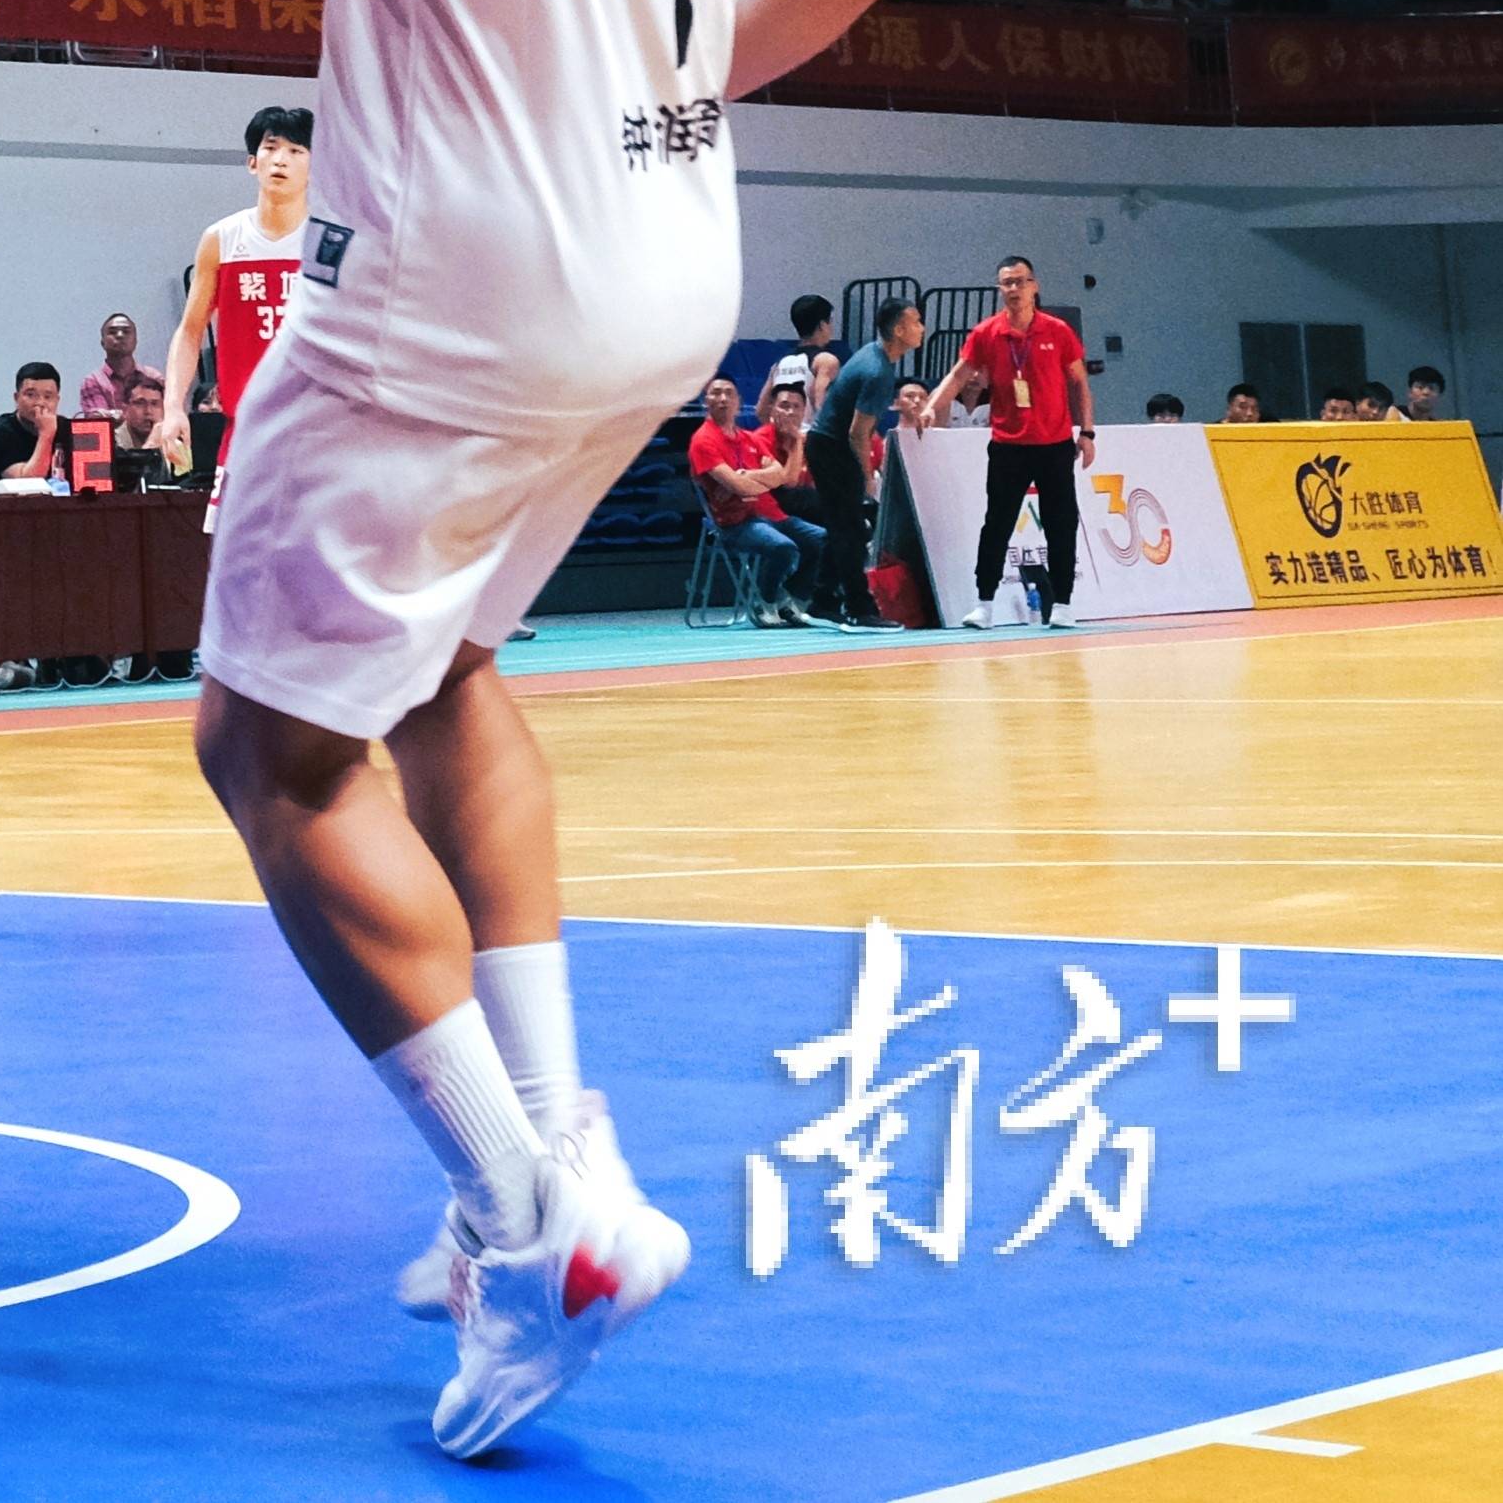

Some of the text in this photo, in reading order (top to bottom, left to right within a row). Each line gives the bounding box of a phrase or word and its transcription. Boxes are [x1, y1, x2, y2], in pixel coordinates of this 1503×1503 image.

[72, 421, 116, 493] 2
[1348, 490, 1424, 516] 大胜体育
